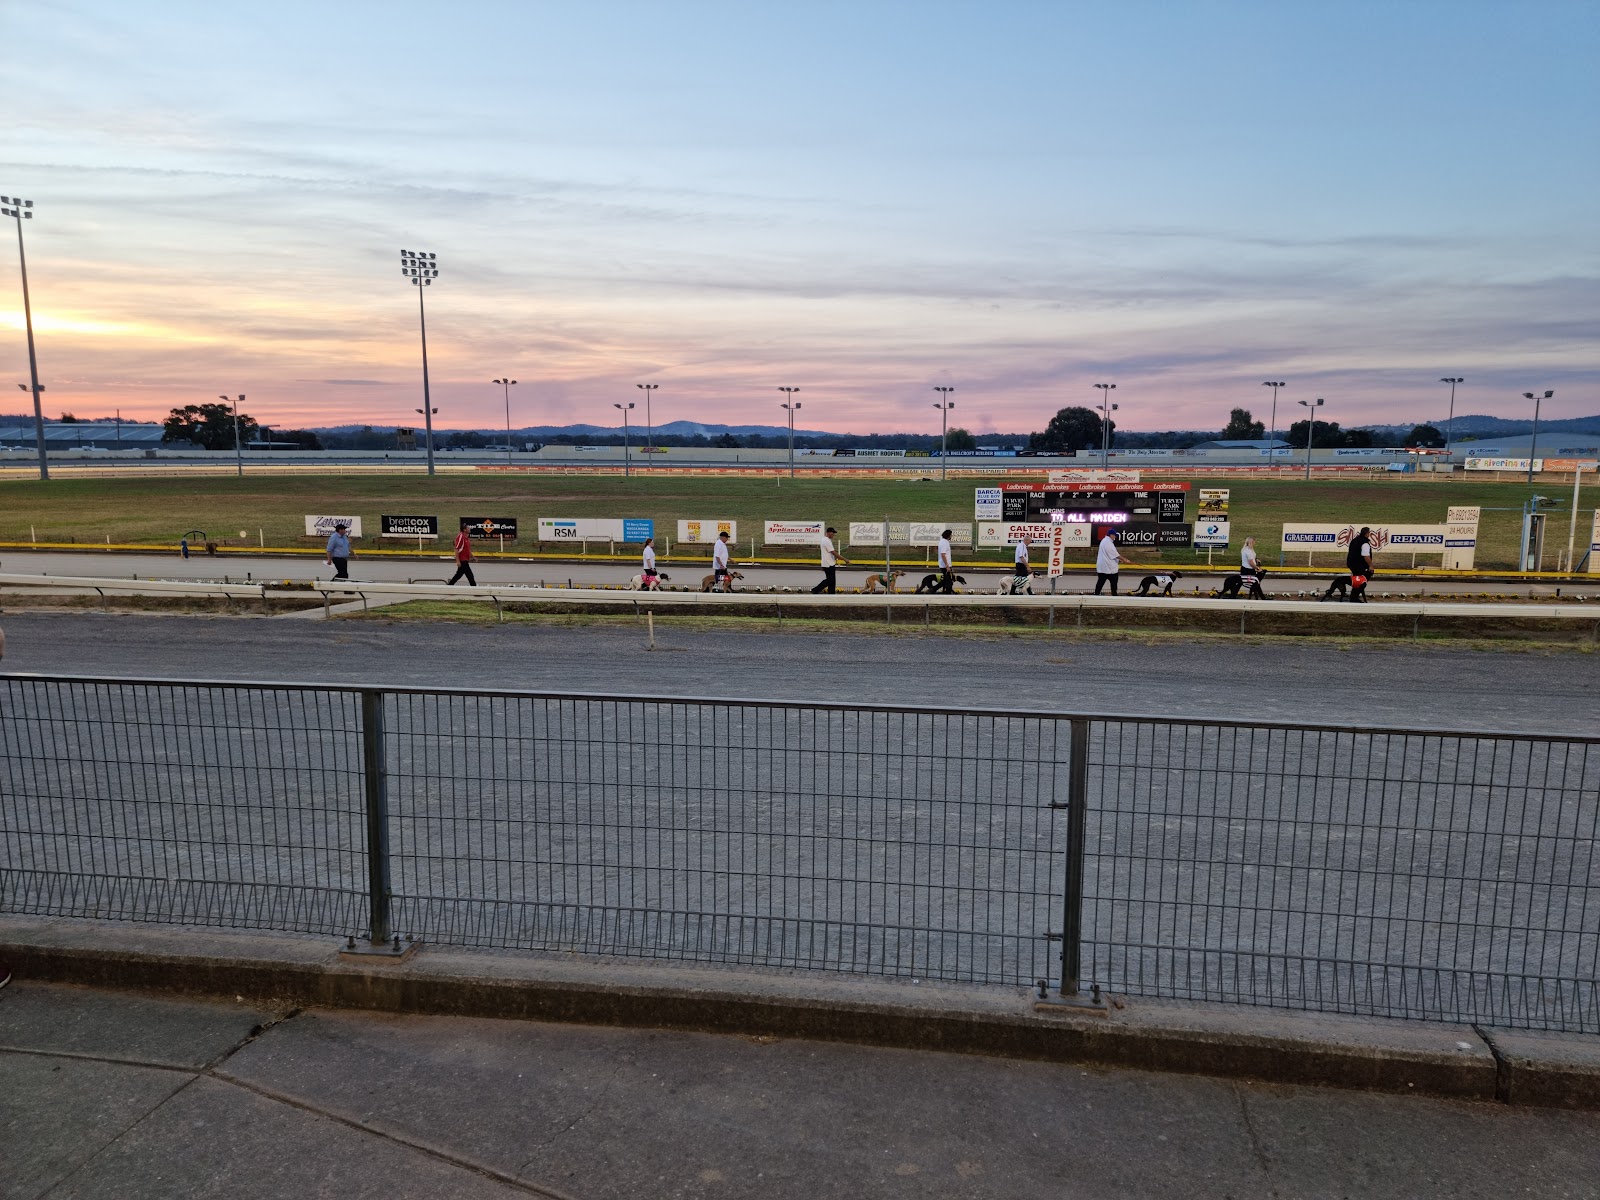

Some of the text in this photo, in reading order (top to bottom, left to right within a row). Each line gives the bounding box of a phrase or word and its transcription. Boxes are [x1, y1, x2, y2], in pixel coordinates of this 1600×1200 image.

[1484, 459, 1518, 467] Riverina
[1067, 514, 1086, 522] ALL
[1090, 514, 1126, 522] MAIDEN
[554, 529, 577, 537] RSM
[1114, 530, 1157, 541] nterior
[1286, 534, 1334, 543] GRAEME HULL
[1336, 526, 1388, 551] SMSH
[1392, 535, 1442, 544] REPAIRS
